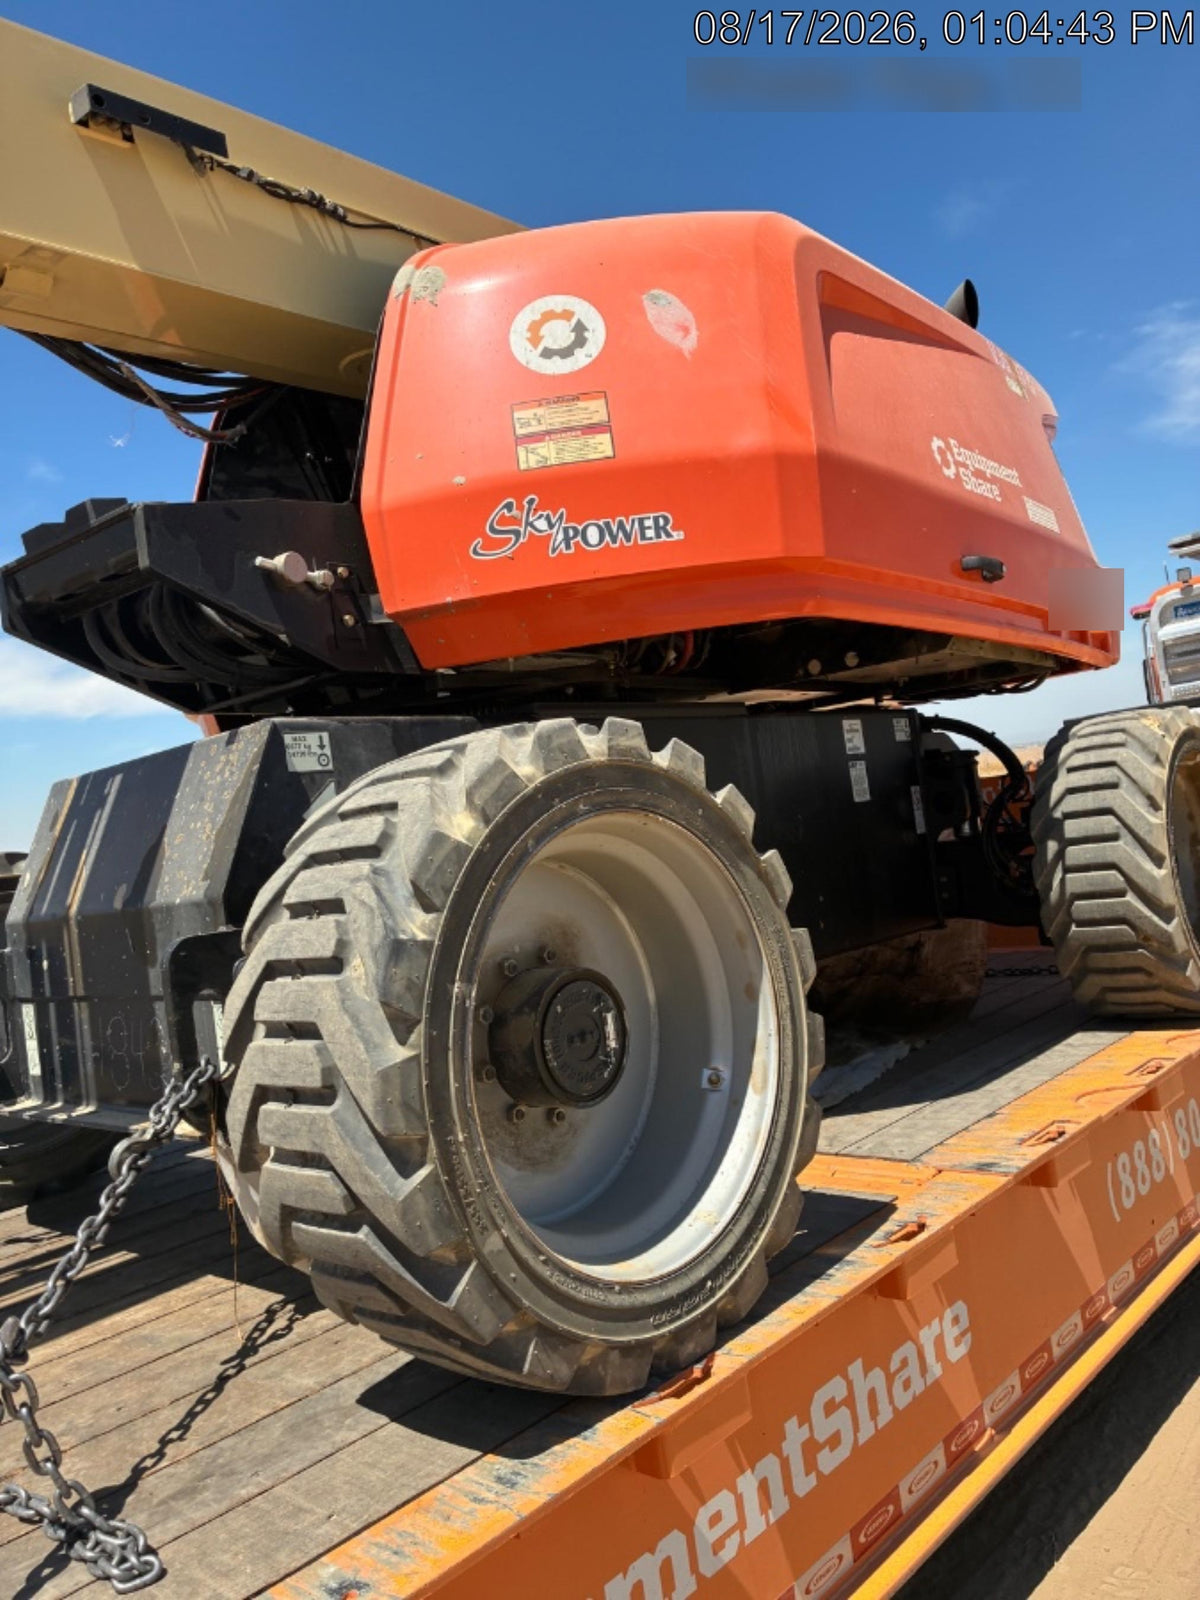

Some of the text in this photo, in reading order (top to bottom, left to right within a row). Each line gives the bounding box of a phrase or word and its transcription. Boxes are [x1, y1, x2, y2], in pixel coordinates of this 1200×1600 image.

[947, 437, 1023, 488] Equipment
[959, 466, 1002, 502] Share
[586, 1299, 972, 1600] mentShare
